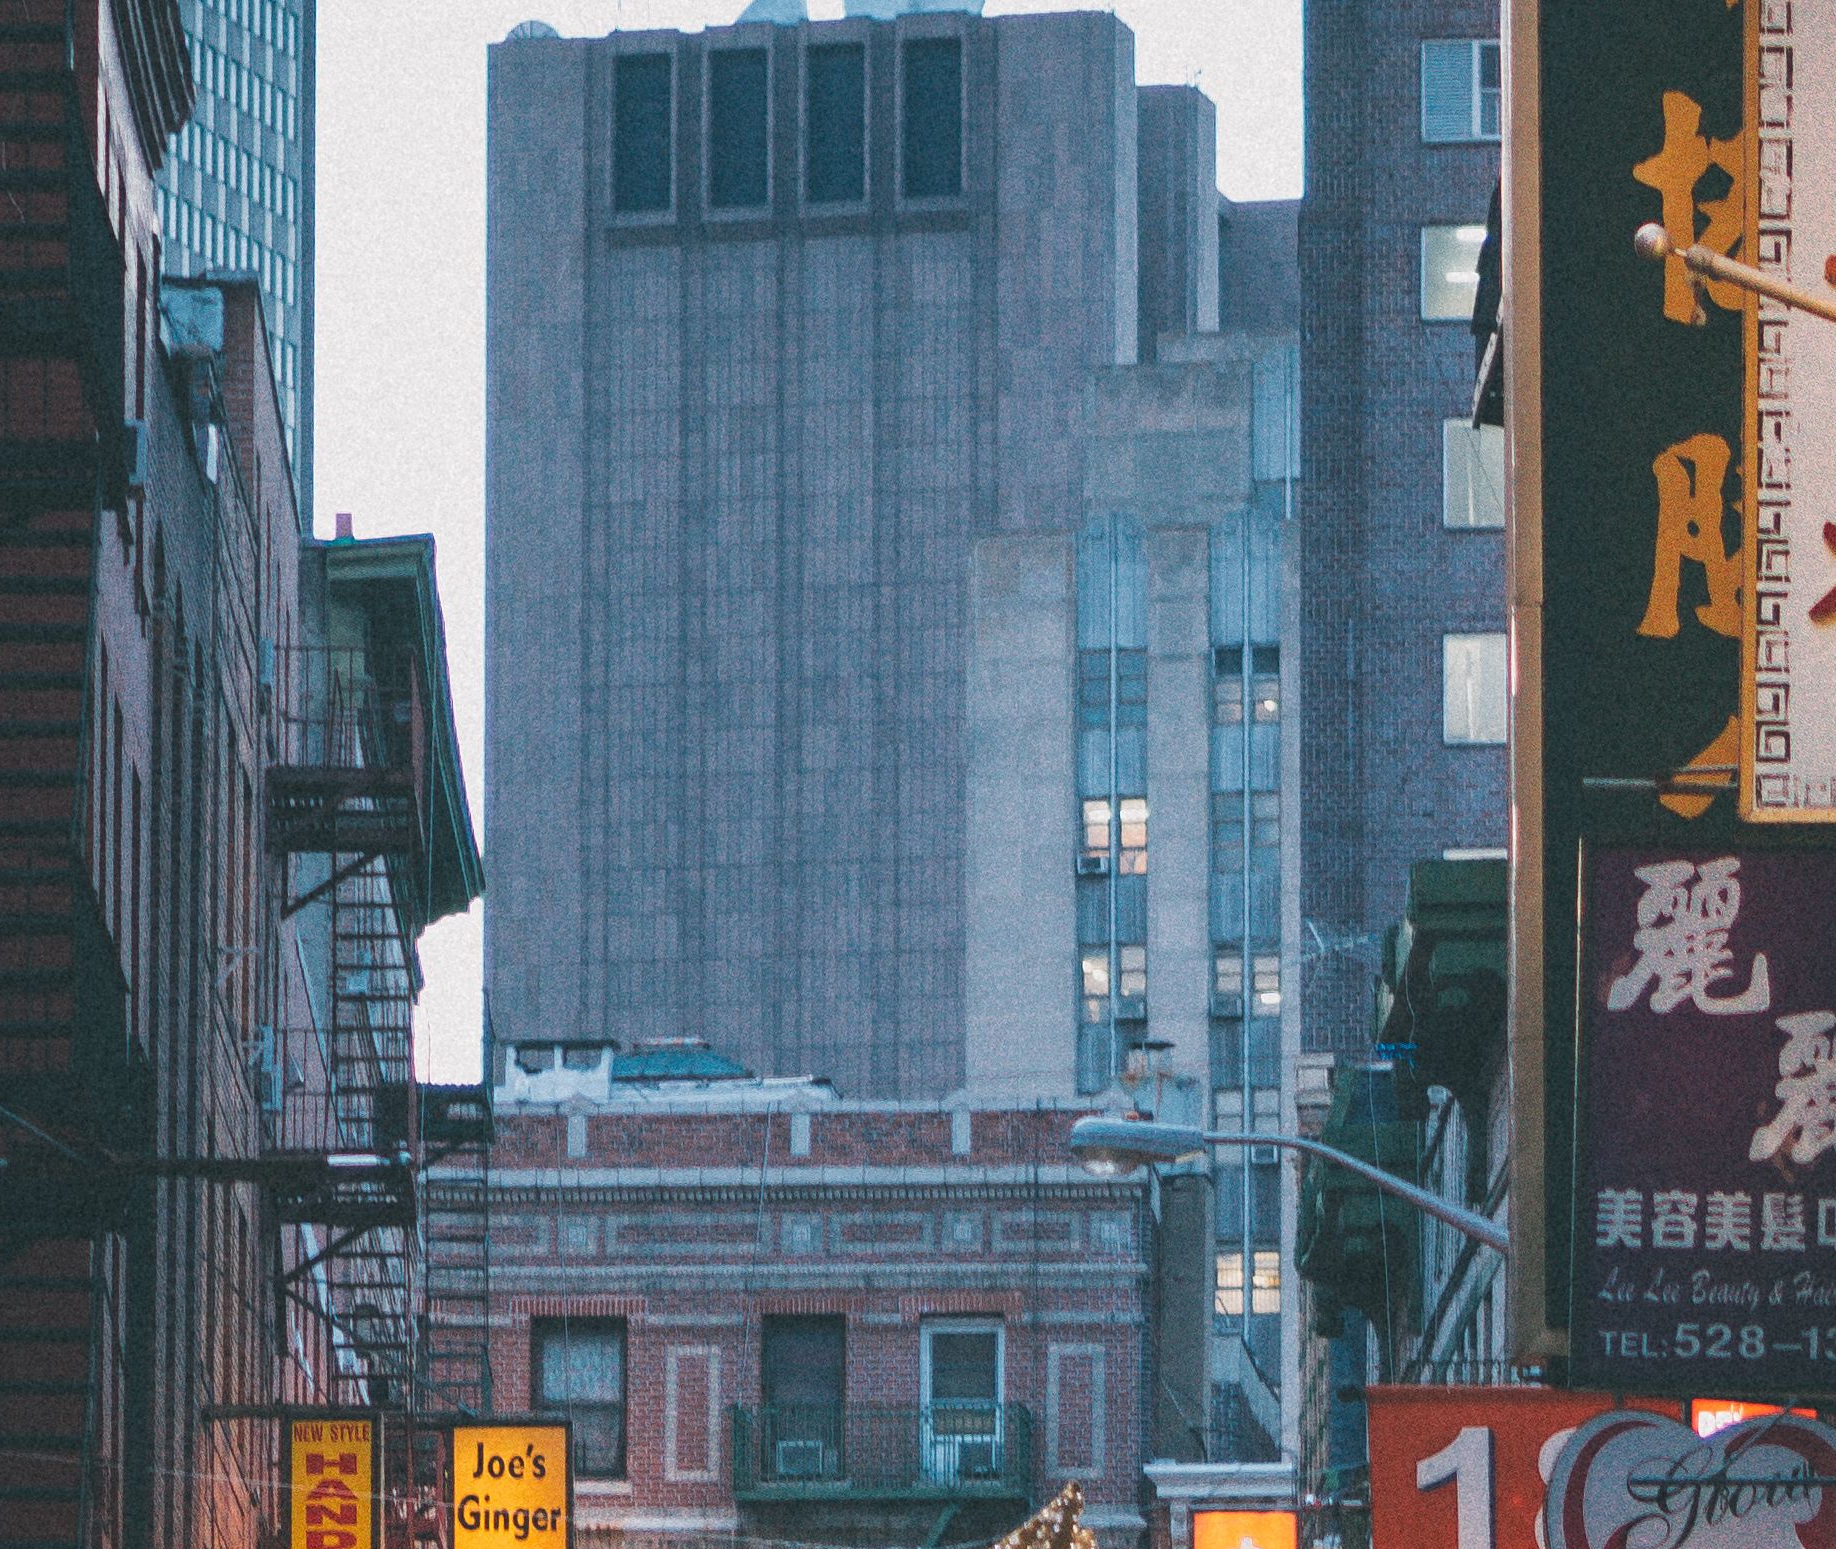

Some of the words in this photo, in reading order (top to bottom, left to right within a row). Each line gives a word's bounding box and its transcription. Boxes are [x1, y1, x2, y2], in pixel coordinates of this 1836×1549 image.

[293, 1423, 323, 1443] NEW
[330, 1423, 370, 1443] STYLE
[473, 1442, 547, 1480] Joe's
[457, 1494, 561, 1541] Ginger
